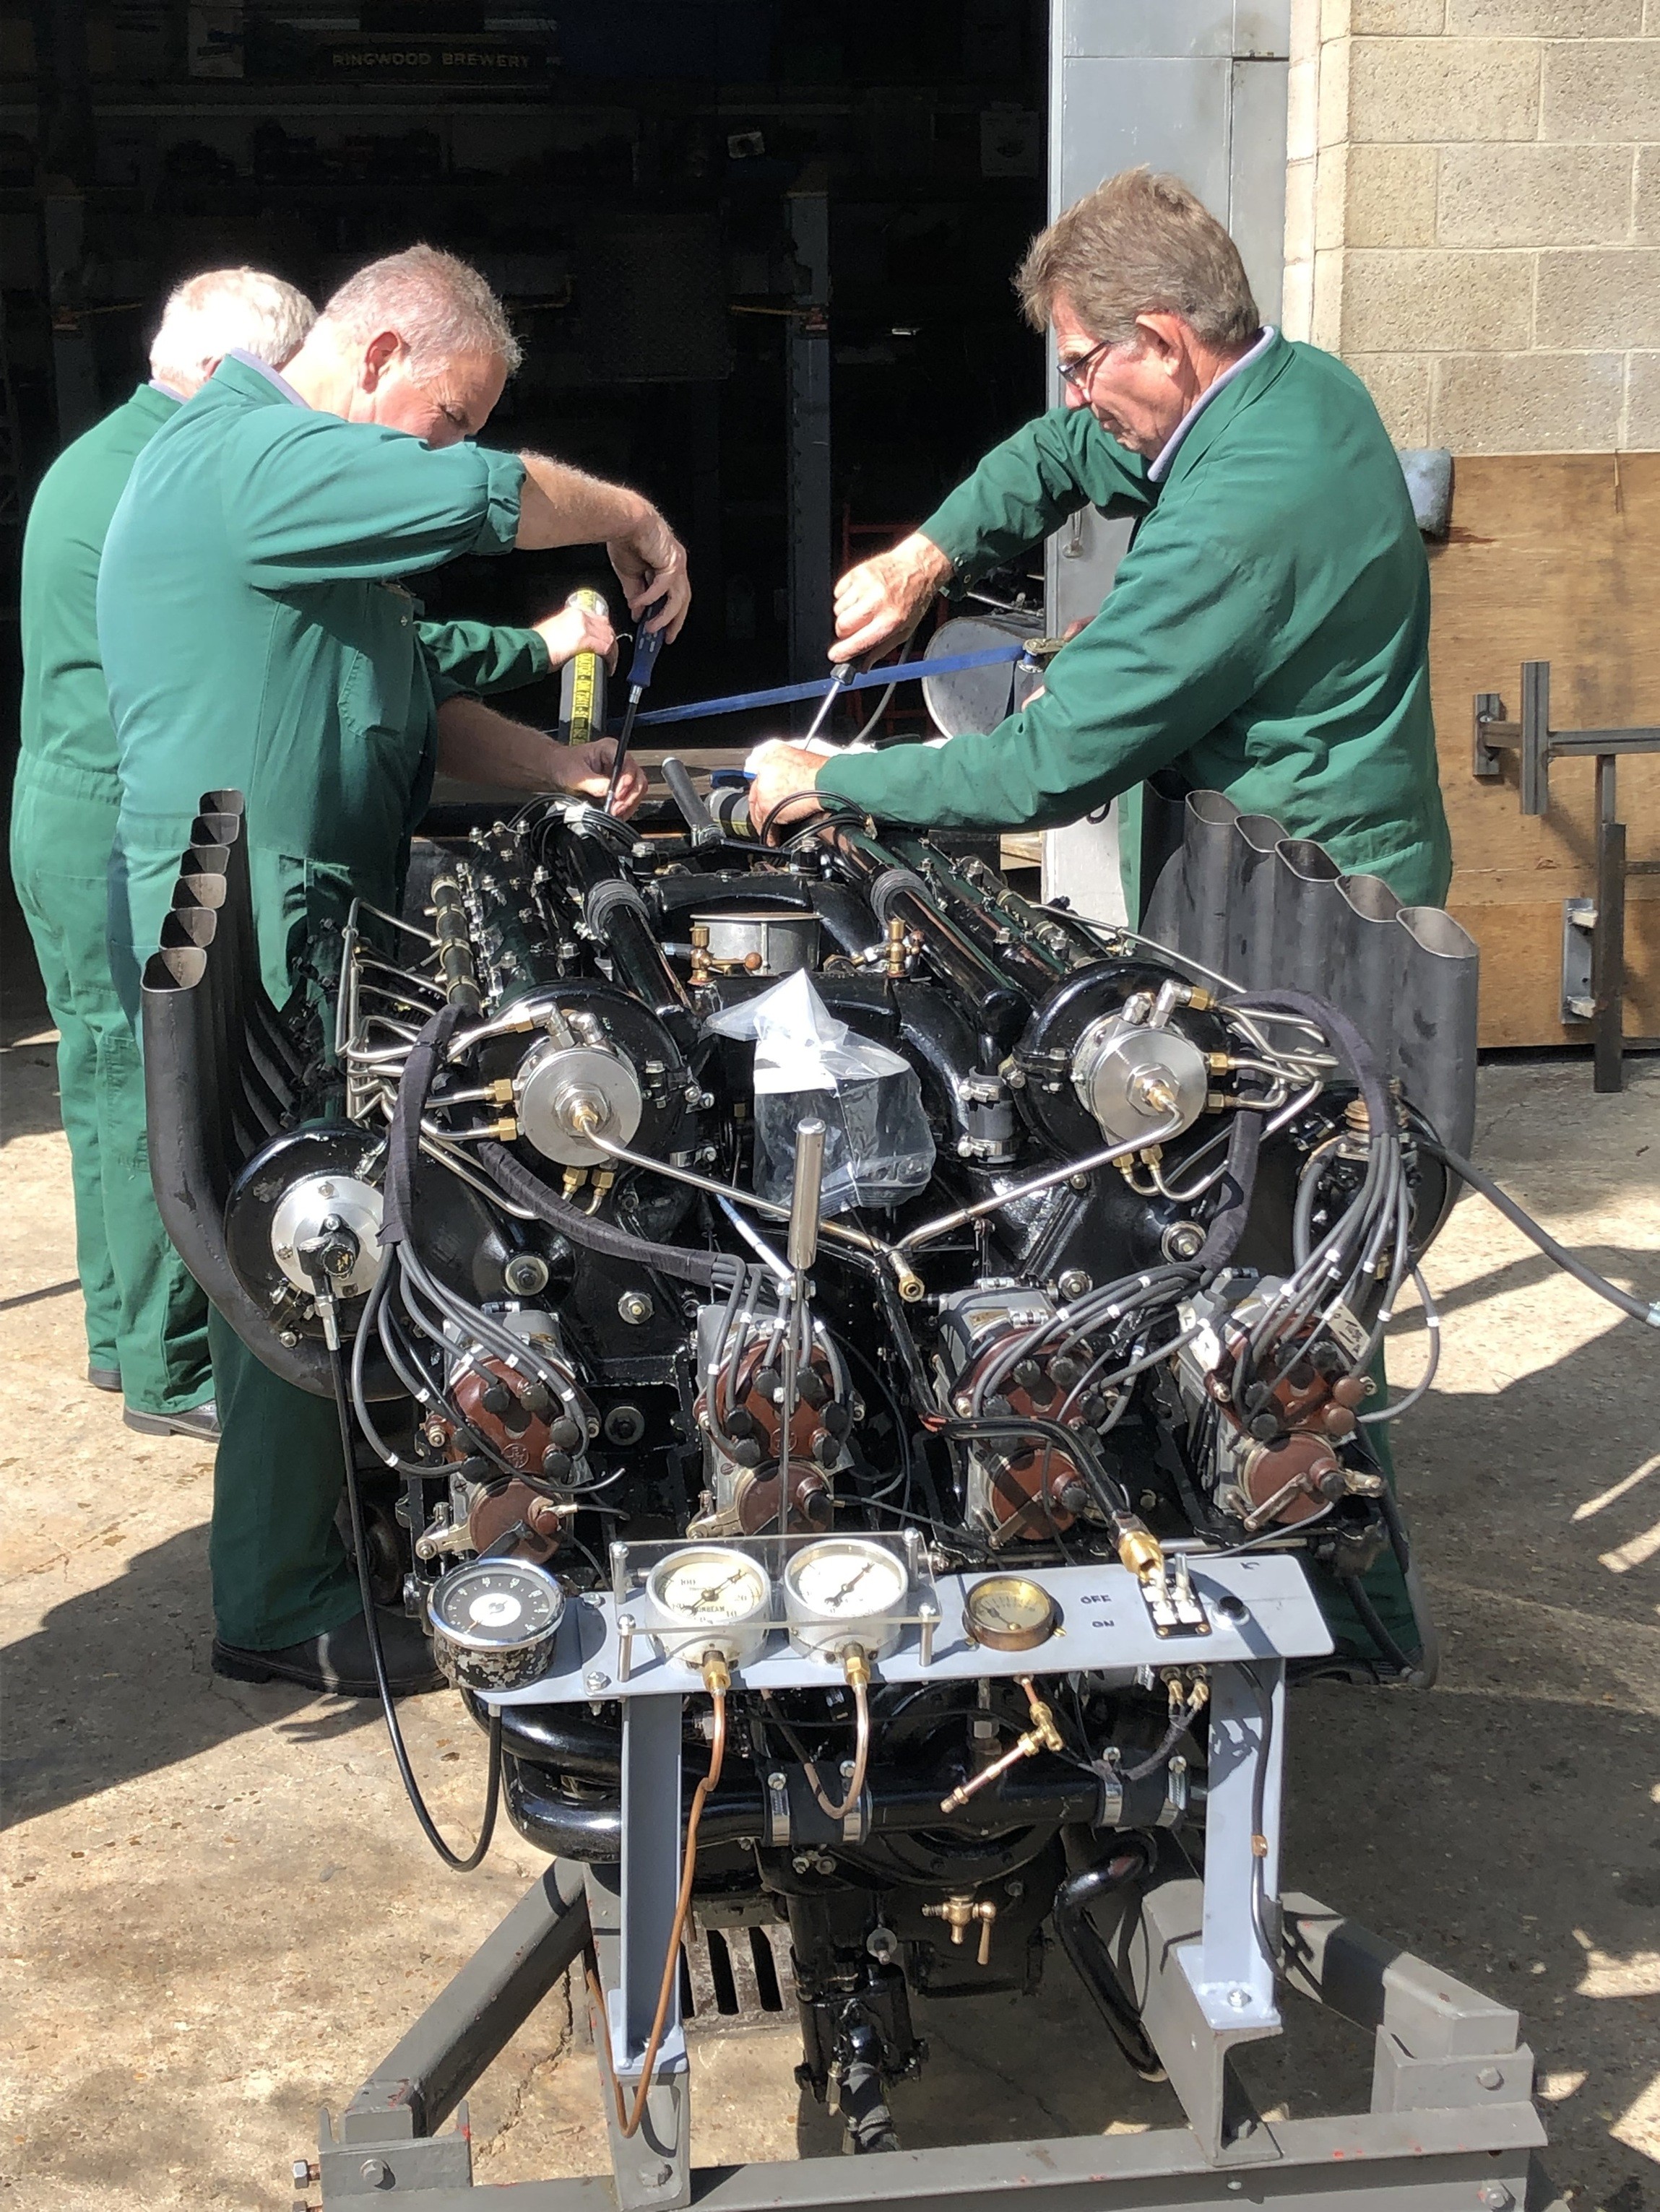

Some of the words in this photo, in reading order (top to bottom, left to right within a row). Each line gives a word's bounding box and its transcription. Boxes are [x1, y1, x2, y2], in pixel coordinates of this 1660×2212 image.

[332, 53, 432, 66] RINGWOOD
[441, 53, 530, 68] BREWERY
[1080, 1595, 1112, 1604] OFF
